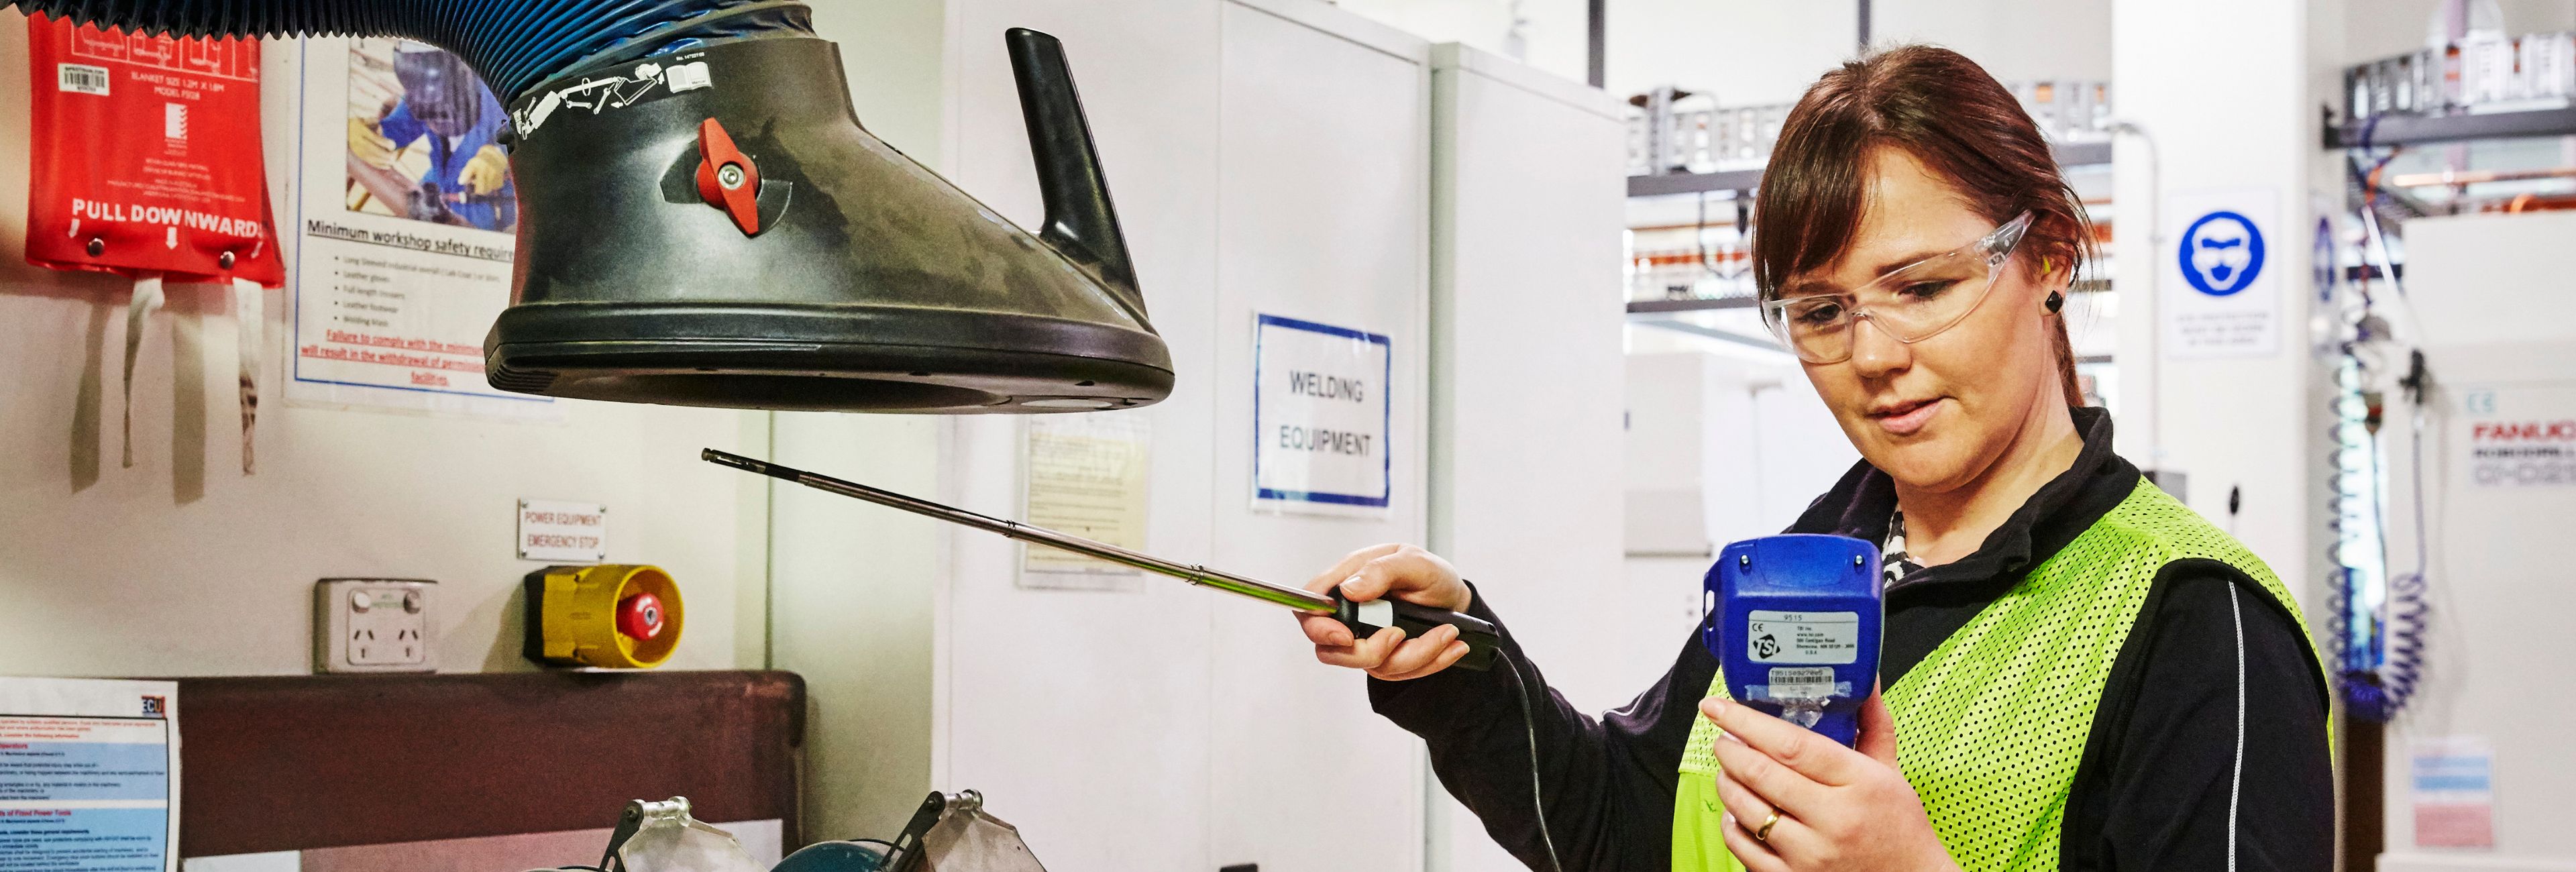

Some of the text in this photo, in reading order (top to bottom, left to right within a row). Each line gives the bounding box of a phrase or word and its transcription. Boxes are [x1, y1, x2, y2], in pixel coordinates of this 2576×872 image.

[131, 71, 164, 84] BLANKET
[166, 76, 180, 87] SIZE
[154, 86, 180, 98] MODEL
[72, 198, 126, 222] PULL
[307, 219, 369, 240] Minimum
[373, 231, 431, 251] workshop
[435, 239, 470, 256] safety
[326, 329, 358, 343] Failure
[361, 333, 370, 343] to
[372, 335, 405, 347] comply
[407, 337, 427, 349] with
[429, 339, 443, 350] the
[301, 344, 319, 356] will
[321, 346, 348, 359] result
[350, 349, 358, 360] in
[361, 350, 375, 362] the
[379, 352, 429, 366] withdrawal
[431, 356, 441, 366] of
[1290, 370, 1362, 402] WELDING
[1281, 425, 1371, 456] EQUIPMENT
[526, 512, 601, 526] POWER EQUIPMENT
[528, 535, 599, 549] EMERGENCY STOP
[1754, 638, 1780, 655] TSI
[142, 697, 162, 712] ECU
